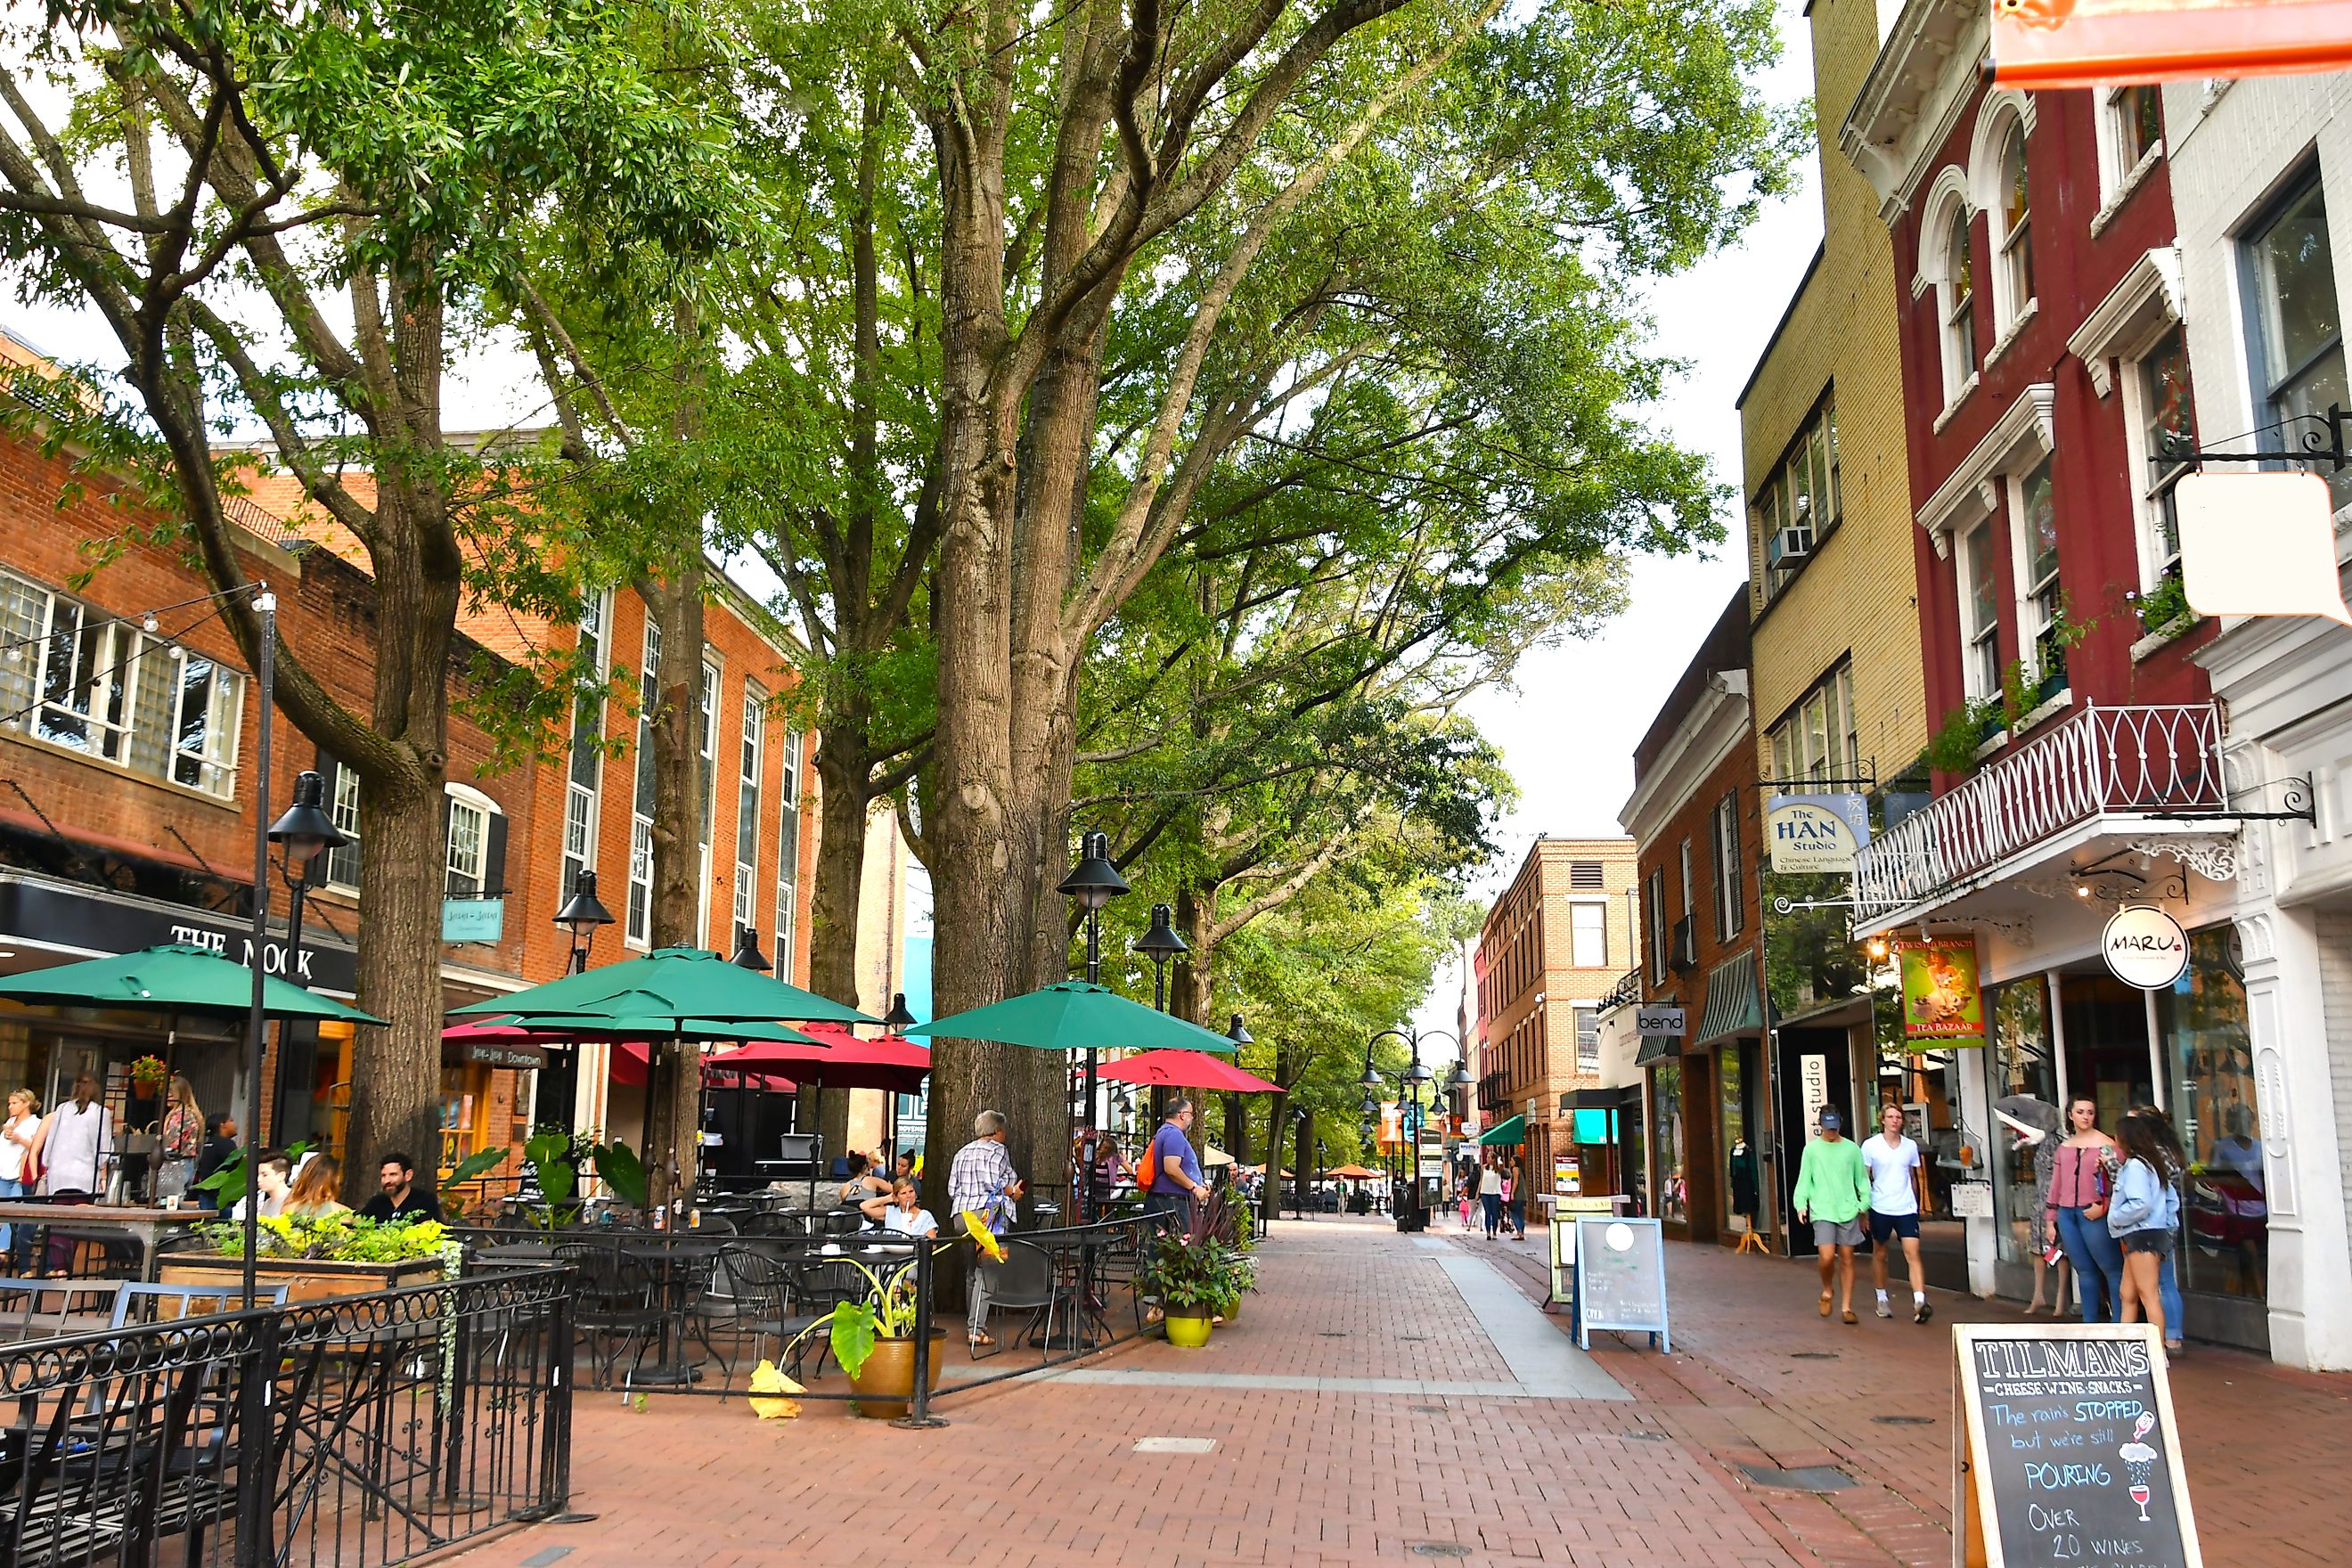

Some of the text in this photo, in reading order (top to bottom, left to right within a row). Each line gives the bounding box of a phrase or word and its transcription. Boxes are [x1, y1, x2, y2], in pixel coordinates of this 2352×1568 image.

[1792, 810, 1814, 819] The
[1776, 820, 1836, 839] HAN
[1793, 841, 1836, 851] Studio
[1813, 856, 1851, 864] Language
[170, 925, 226, 953] THE
[1899, 941, 1937, 949] TWISTED
[2111, 935, 2175, 951] MARU
[1638, 1012, 1683, 1029] bend
[1915, 1023, 1973, 1032] TEA BAZAAR
[1806, 1060, 1822, 1114] studio
[1989, 1400, 2143, 1425] The rain's STOPPED
[2010, 1429, 2113, 1449] but we're still
[2024, 1462, 2111, 1490] POURING
[2028, 1503, 2080, 1531] OVER
[2053, 1533, 2144, 1559] 20 WINES
